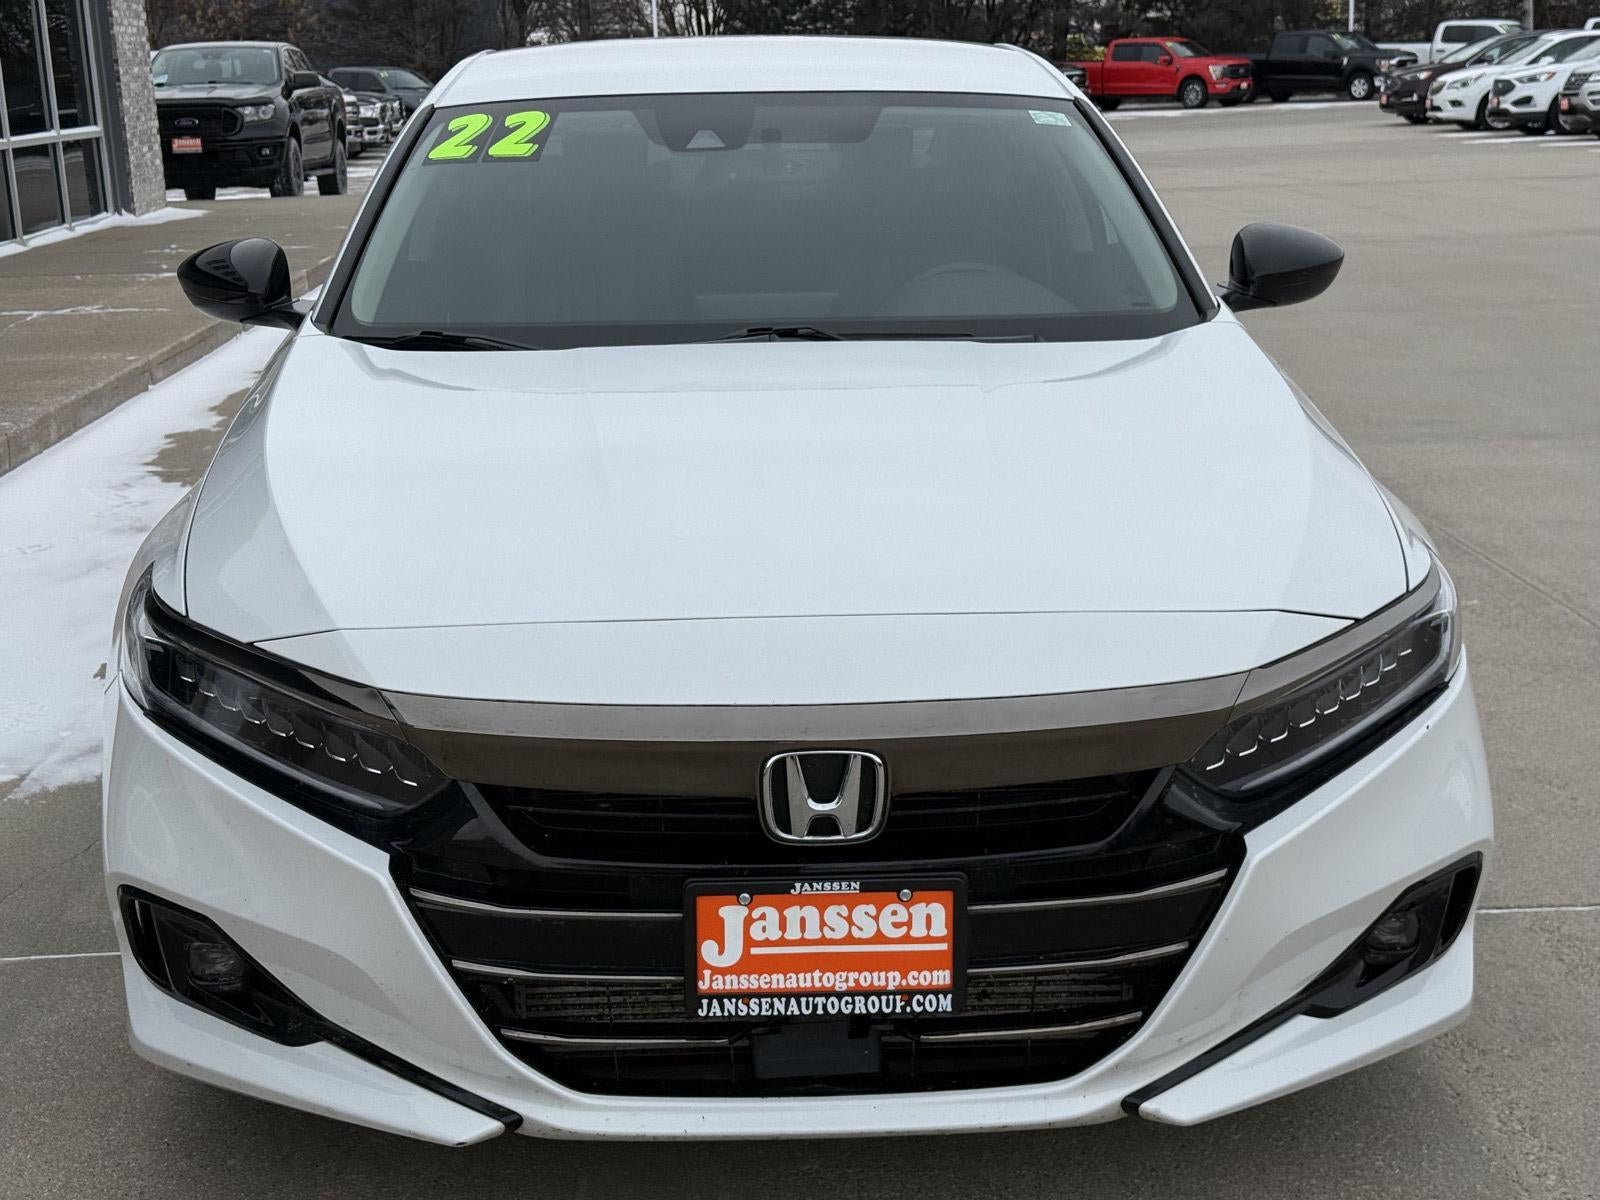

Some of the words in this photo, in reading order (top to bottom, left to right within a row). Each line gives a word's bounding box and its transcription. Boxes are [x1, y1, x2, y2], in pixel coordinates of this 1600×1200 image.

[428, 111, 551, 160] 22
[790, 881, 861, 895] JANSSEN
[701, 902, 948, 967] Janssen
[698, 969, 951, 991] Janssenautogroup.com
